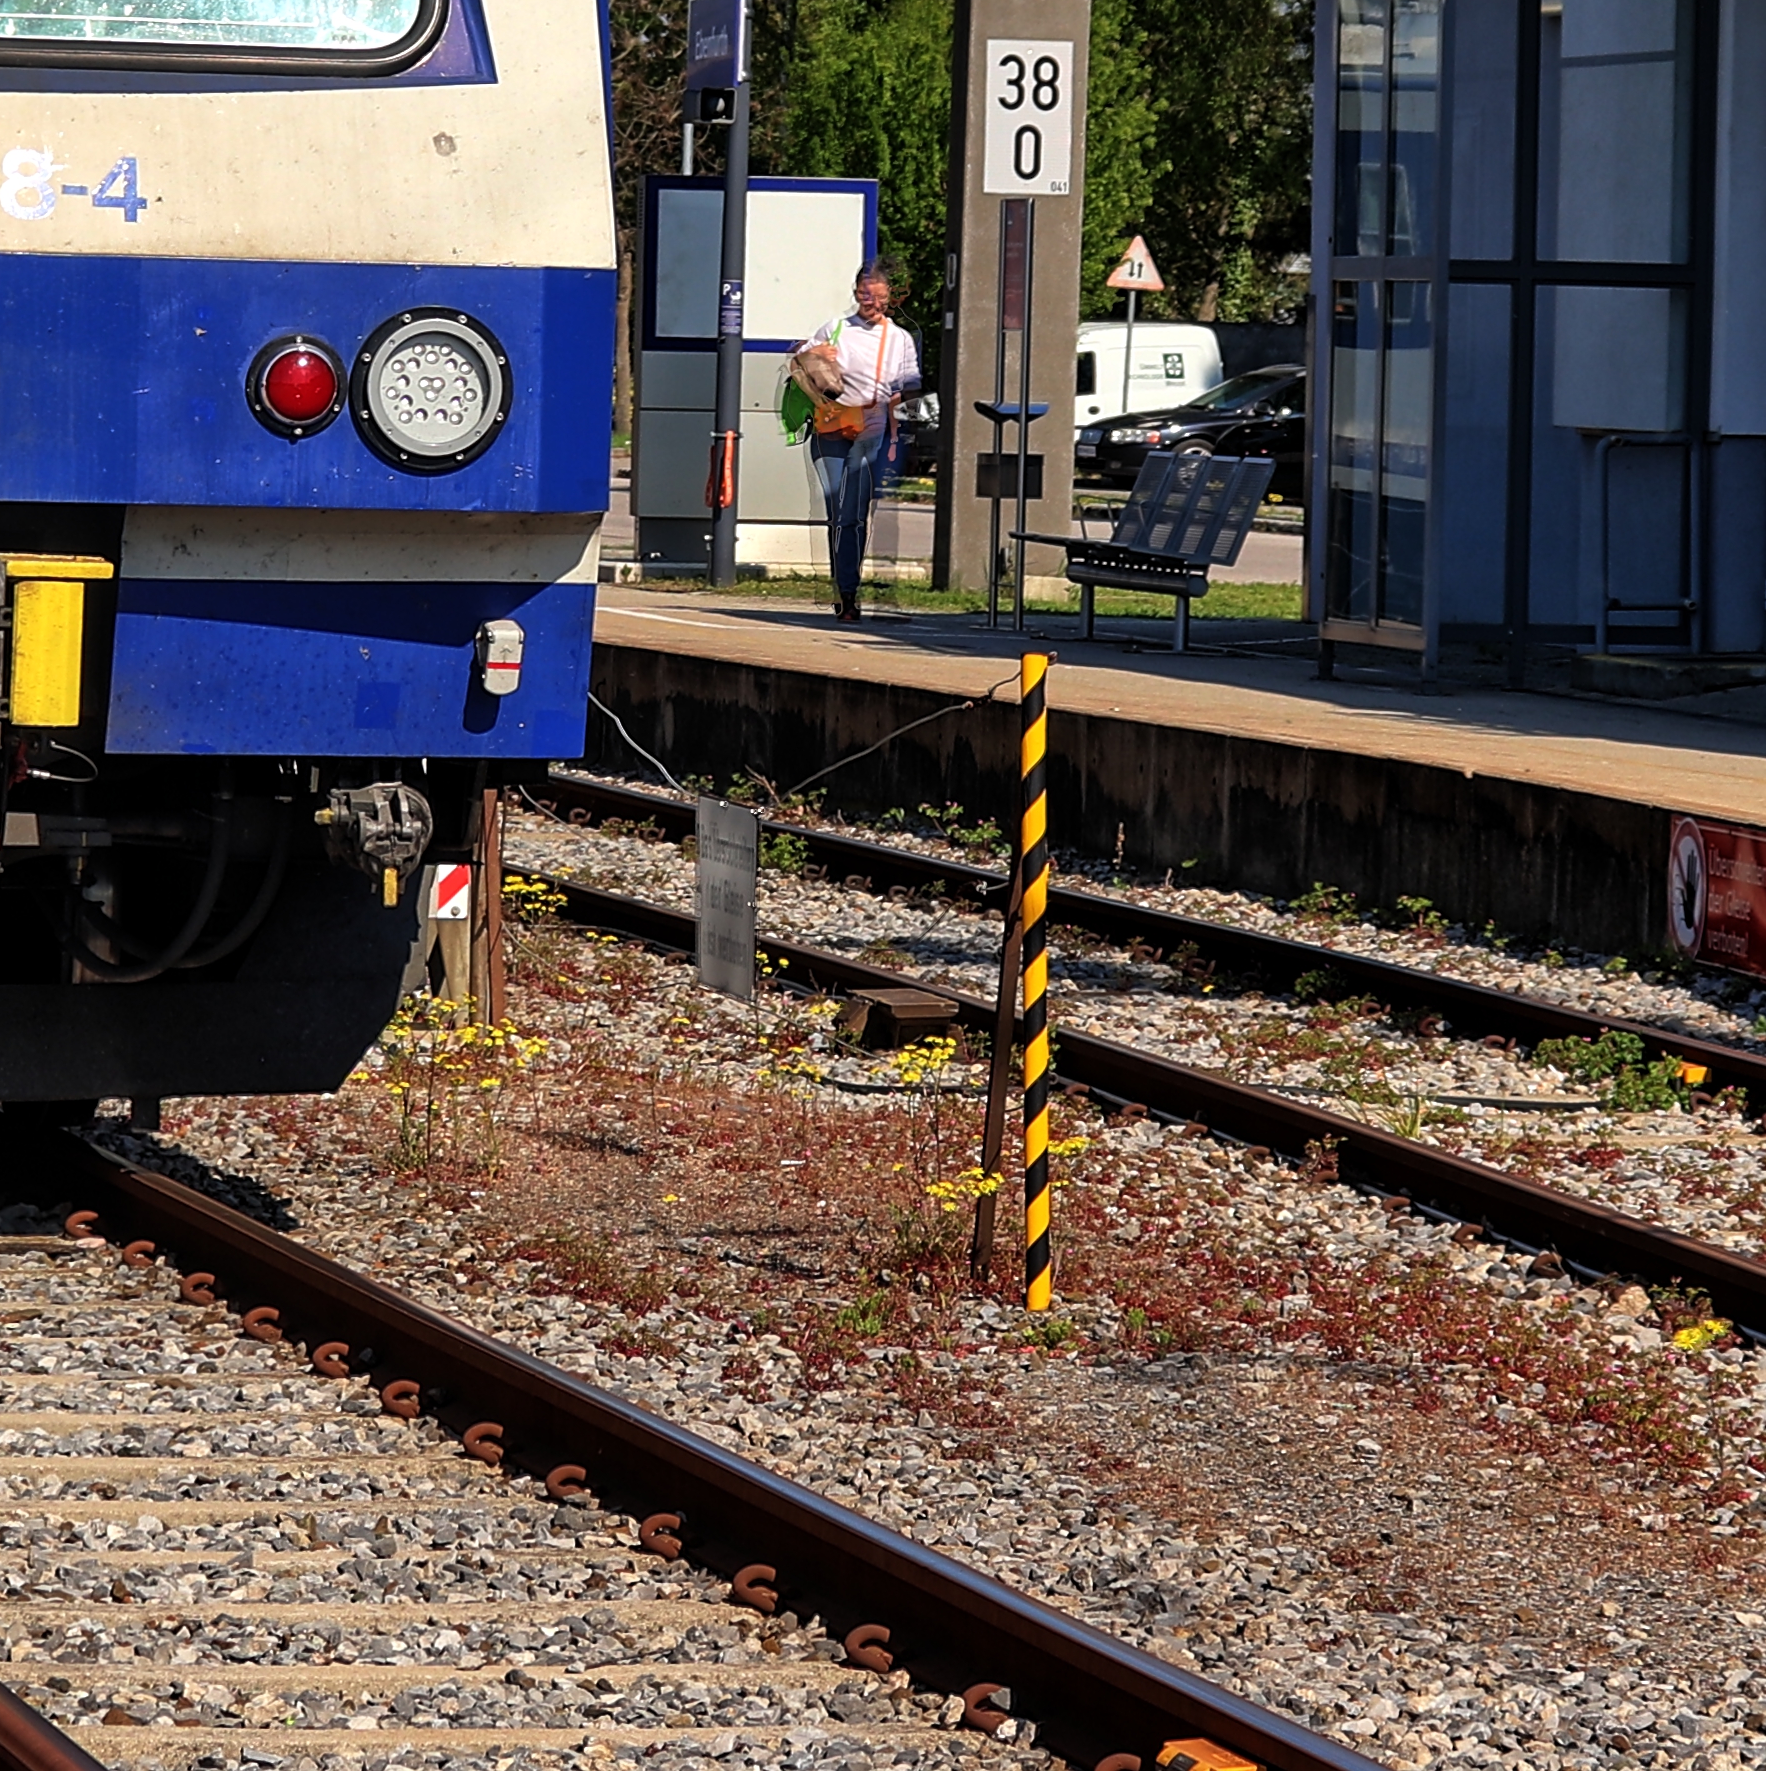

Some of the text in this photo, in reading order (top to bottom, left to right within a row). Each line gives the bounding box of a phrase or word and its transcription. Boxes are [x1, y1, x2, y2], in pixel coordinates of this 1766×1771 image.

[998, 54, 1060, 111] 38
[1014, 124, 1042, 180] 0
[1050, 182, 1068, 192] 041
